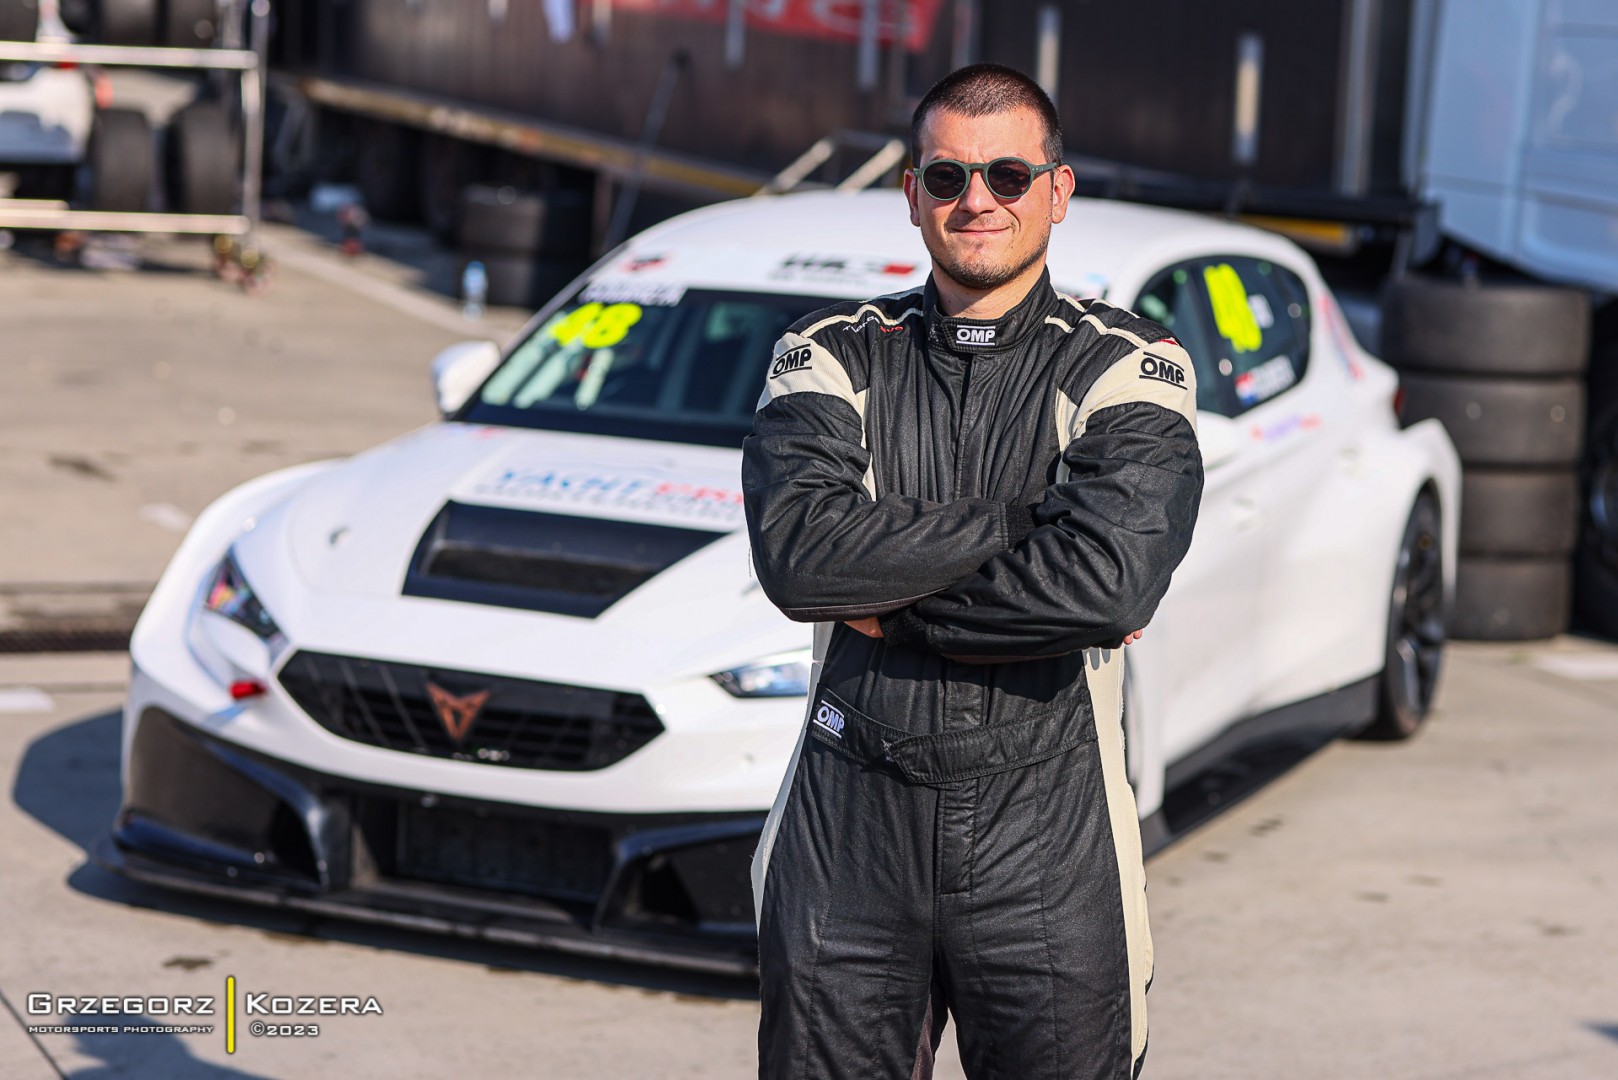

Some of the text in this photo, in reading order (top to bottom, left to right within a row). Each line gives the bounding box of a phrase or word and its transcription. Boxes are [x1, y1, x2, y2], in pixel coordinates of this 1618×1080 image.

[956, 328, 996, 343] OMP
[772, 348, 812, 375] OMP
[1139, 356, 1185, 384] OMP
[816, 705, 845, 733] OMP
